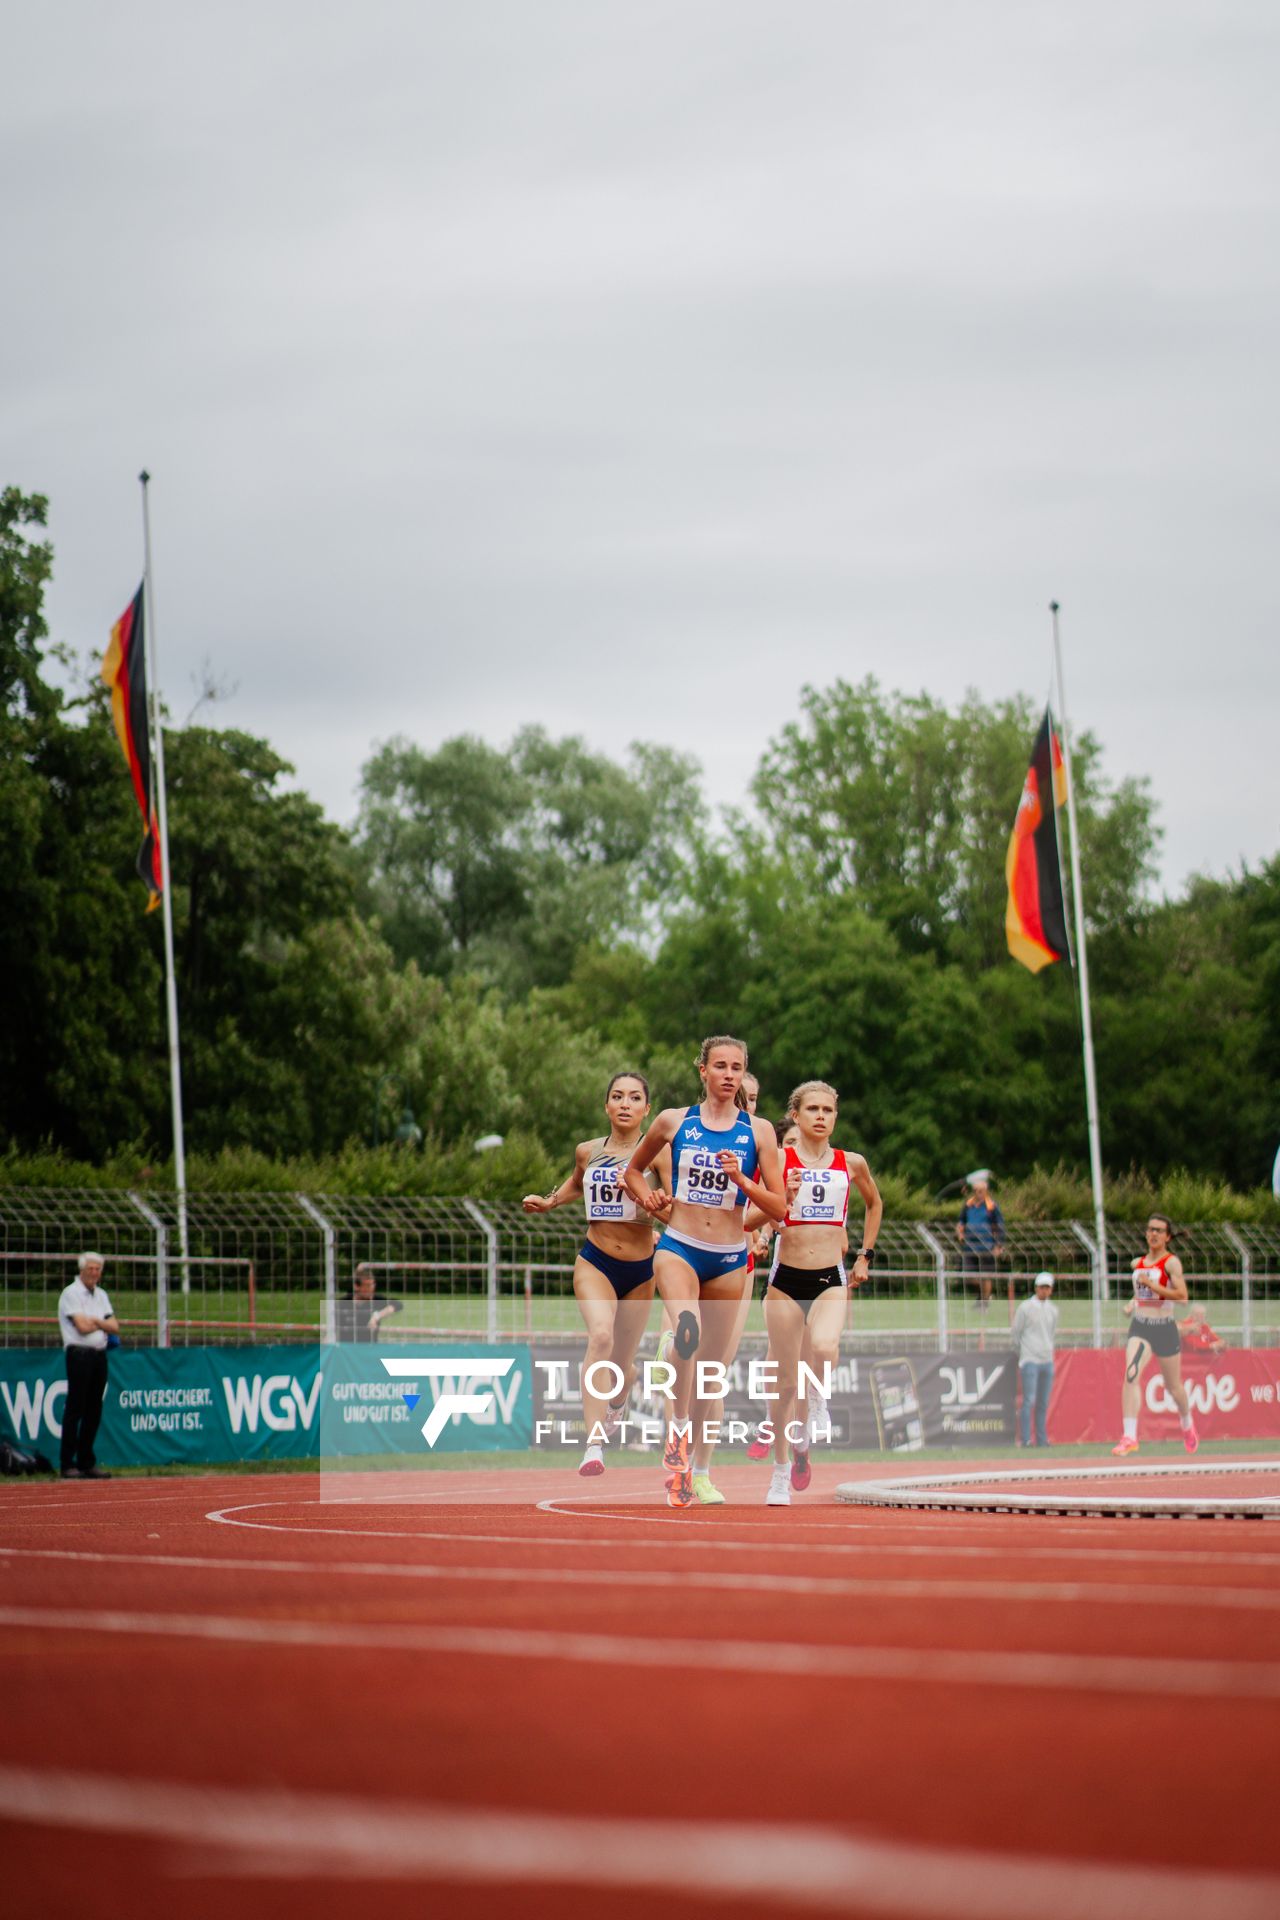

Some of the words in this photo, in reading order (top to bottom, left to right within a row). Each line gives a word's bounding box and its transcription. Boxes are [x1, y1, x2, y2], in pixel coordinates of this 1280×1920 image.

[692, 1153, 723, 1169] GLS
[592, 1169, 618, 1182] GLS
[687, 1167, 730, 1192] 589
[801, 1171, 831, 1183] GLS
[589, 1184, 624, 1203] 167
[701, 1193, 722, 1202] PLAN
[812, 1184, 826, 1204] 9
[332, 1384, 356, 1401] GUT
[939, 1365, 1005, 1405] DLV
[1250, 1385, 1274, 1403] we
[119, 1390, 142, 1408] GUT
[143, 1388, 213, 1407] VERSICHERT.
[222, 1371, 323, 1434] WGV
[131, 1413, 157, 1432] UND
[158, 1413, 181, 1431] GUT
[182, 1412, 203, 1430] IST.
[343, 1406, 369, 1423] UND
[369, 1406, 389, 1423] GUT
